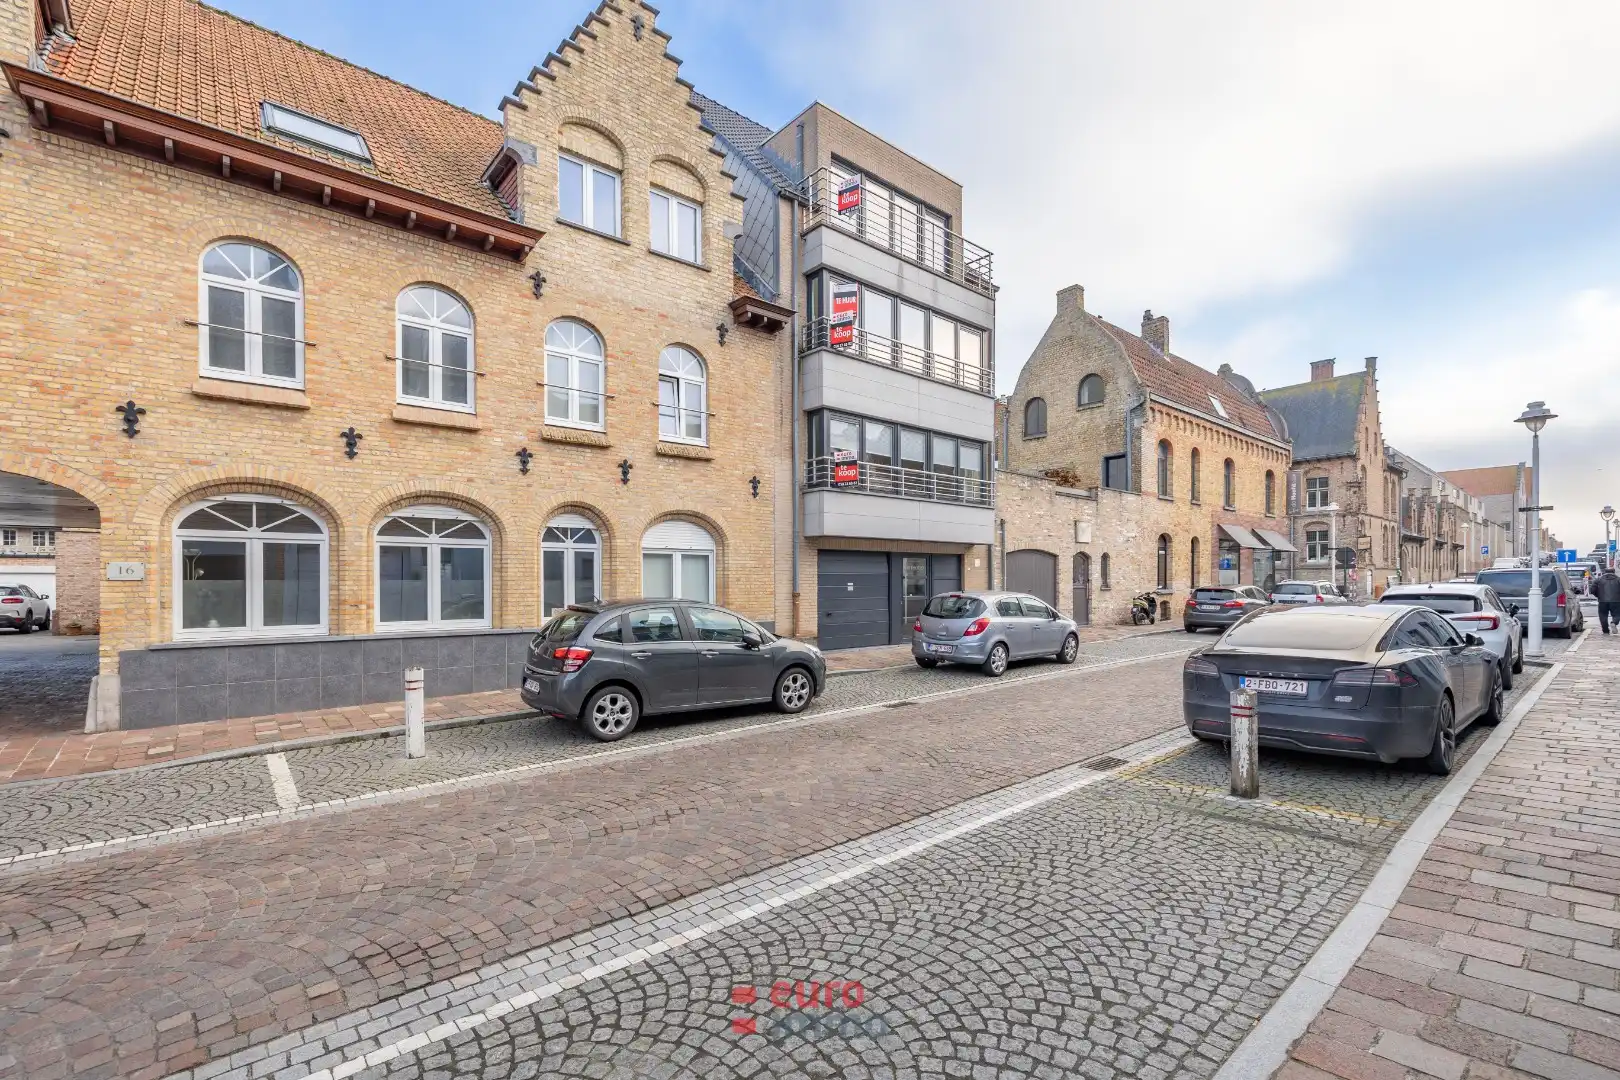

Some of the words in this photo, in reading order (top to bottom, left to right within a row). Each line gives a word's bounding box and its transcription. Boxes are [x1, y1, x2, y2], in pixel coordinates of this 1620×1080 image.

[841, 193, 858, 204] koop
[834, 330, 851, 339] koop
[838, 469, 856, 477] koop
[119, 565, 135, 574] 16
